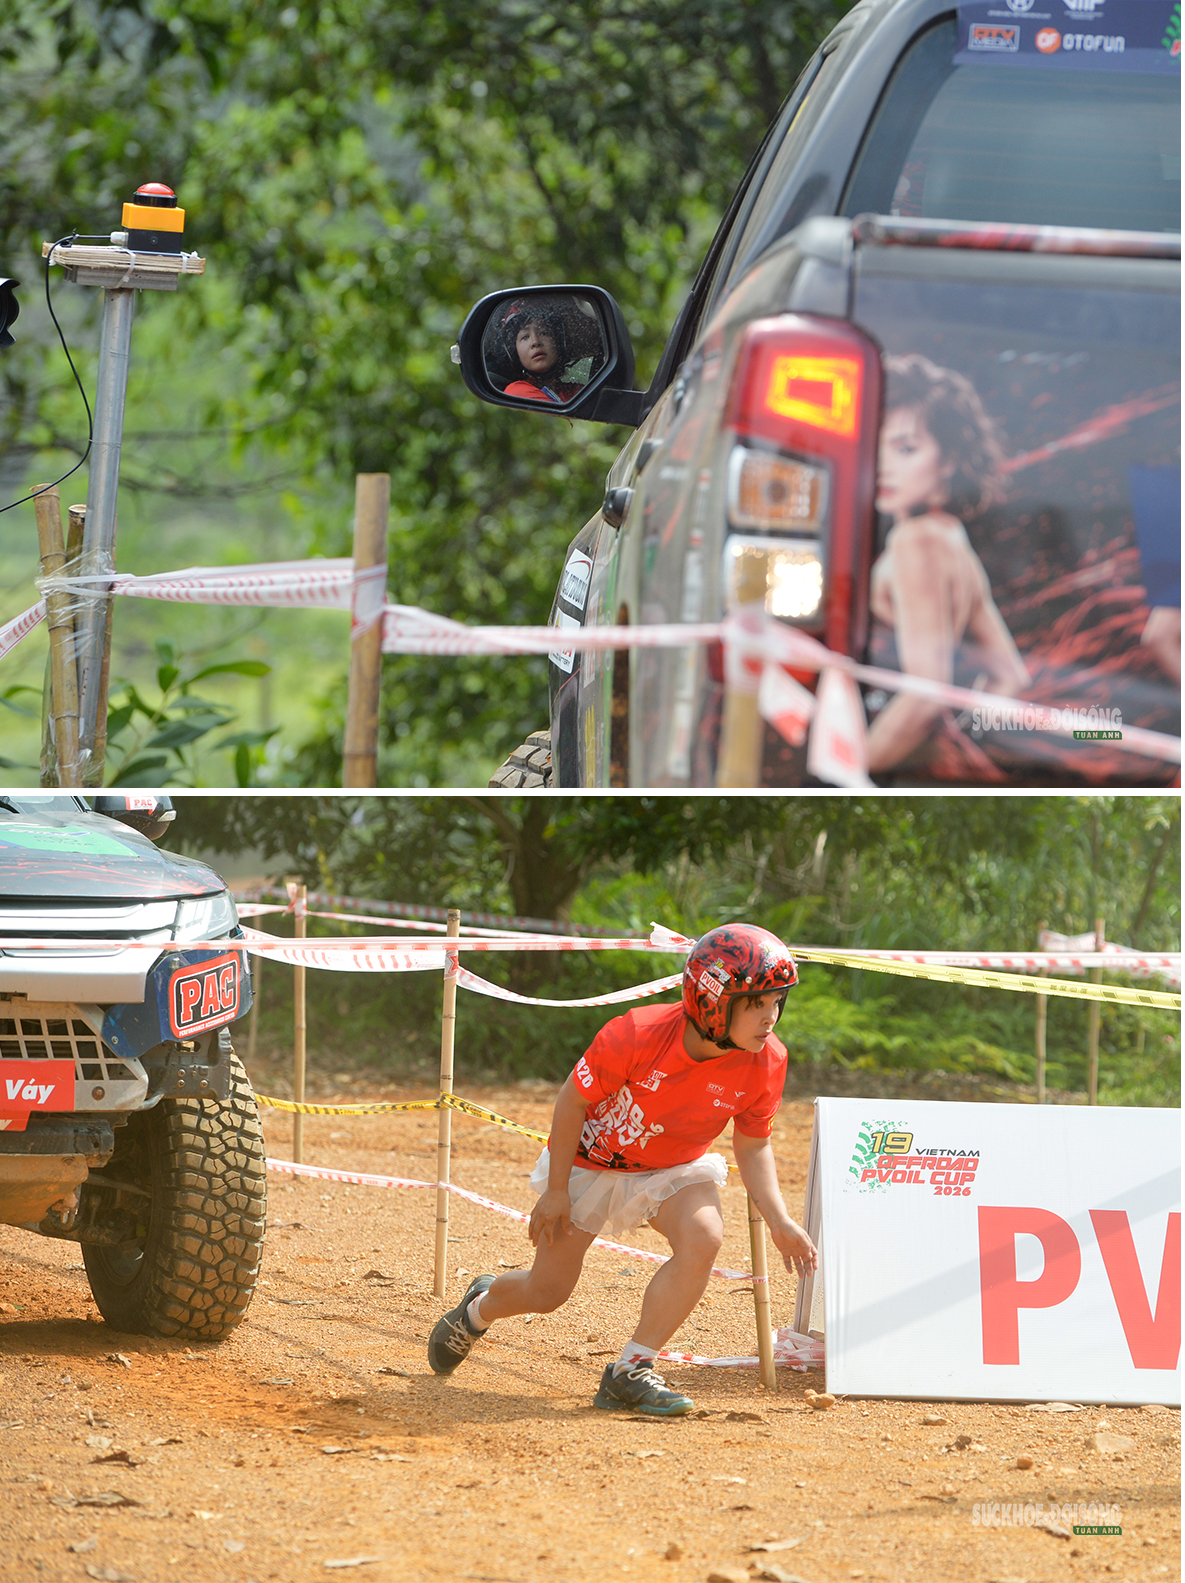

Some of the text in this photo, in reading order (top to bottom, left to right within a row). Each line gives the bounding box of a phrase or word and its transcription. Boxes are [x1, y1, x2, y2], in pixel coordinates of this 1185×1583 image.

[134, 799, 153, 807] PAC
[701, 972, 721, 995] PVOIL
[180, 966, 234, 1024] PAC
[5, 1078, 56, 1104] Váy
[871, 1131, 914, 1154] 19
[915, 1148, 980, 1157] VIETNAM
[876, 1155, 979, 1171] OFFROAD
[860, 1169, 976, 1186] PVOIL CUP
[933, 1186, 971, 1197] 2026
[977, 1206, 1181, 1371] PV
